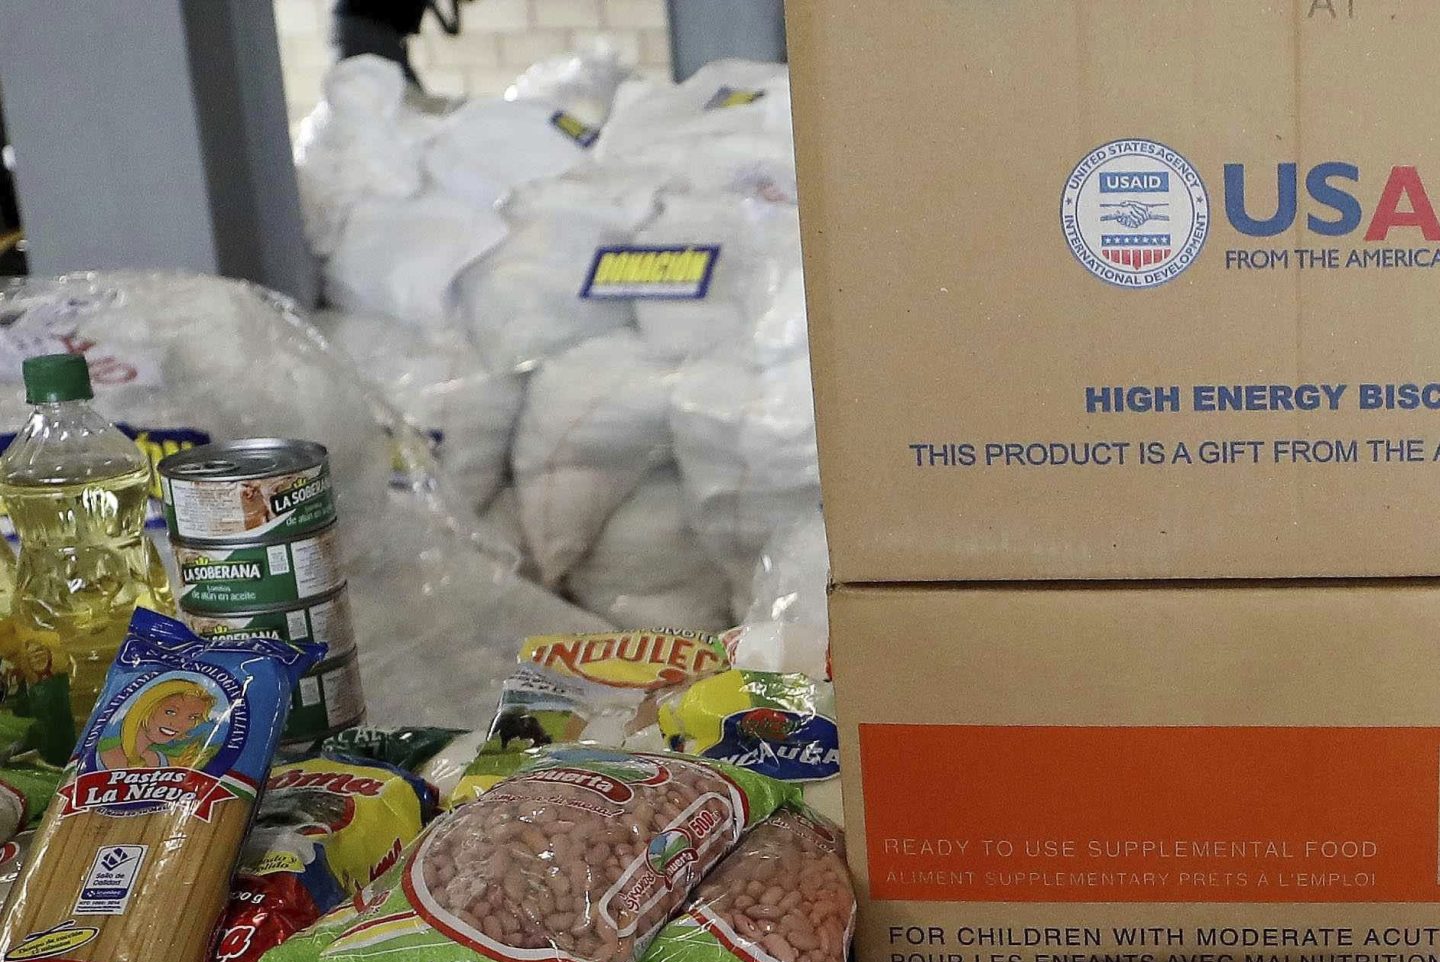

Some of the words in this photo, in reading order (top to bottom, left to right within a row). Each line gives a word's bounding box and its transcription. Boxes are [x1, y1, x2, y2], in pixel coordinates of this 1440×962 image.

[1070, 151, 1106, 190] UNITED
[1108, 142, 1156, 156] STATES
[1156, 148, 1200, 189] AGENCY
[1106, 175, 1162, 189] USAID
[1064, 214, 1142, 285] INTERNATIONAL
[1144, 212, 1206, 285] DEVELOPMENT
[1226, 250, 1288, 270] FROM
[1294, 249, 1339, 269] THE
[1086, 386, 1180, 413] HIGH
[1193, 384, 1347, 412] ENERGY
[909, 444, 976, 466] THIS
[985, 443, 1130, 465] PRODUCT
[1140, 442, 1165, 464] IS
[1172, 442, 1192, 464] A
[1199, 441, 1264, 464] GIFT
[1274, 440, 1357, 464] FROM
[1366, 439, 1424, 462] THE
[184, 568, 194, 581] LA
[195, 563, 261, 581] SOBERANA
[107, 770, 187, 785] Pastas
[85, 786, 118, 805] La
[123, 784, 198, 804] Nieve
[884, 839, 968, 857] READY
[983, 840, 1014, 857] TO
[1026, 840, 1075, 858] USE
[1088, 840, 1294, 858] SUPPLEMENTAL
[1306, 841, 1378, 858] FOOD
[885, 871, 974, 886] ALIMENT
[1278, 871, 1376, 887] L'EMPLOI
[889, 927, 945, 946] FOR
[958, 927, 1101, 946] CHILDREN
[1113, 927, 1184, 946] WITH
[1198, 927, 1353, 947] MODERATE
